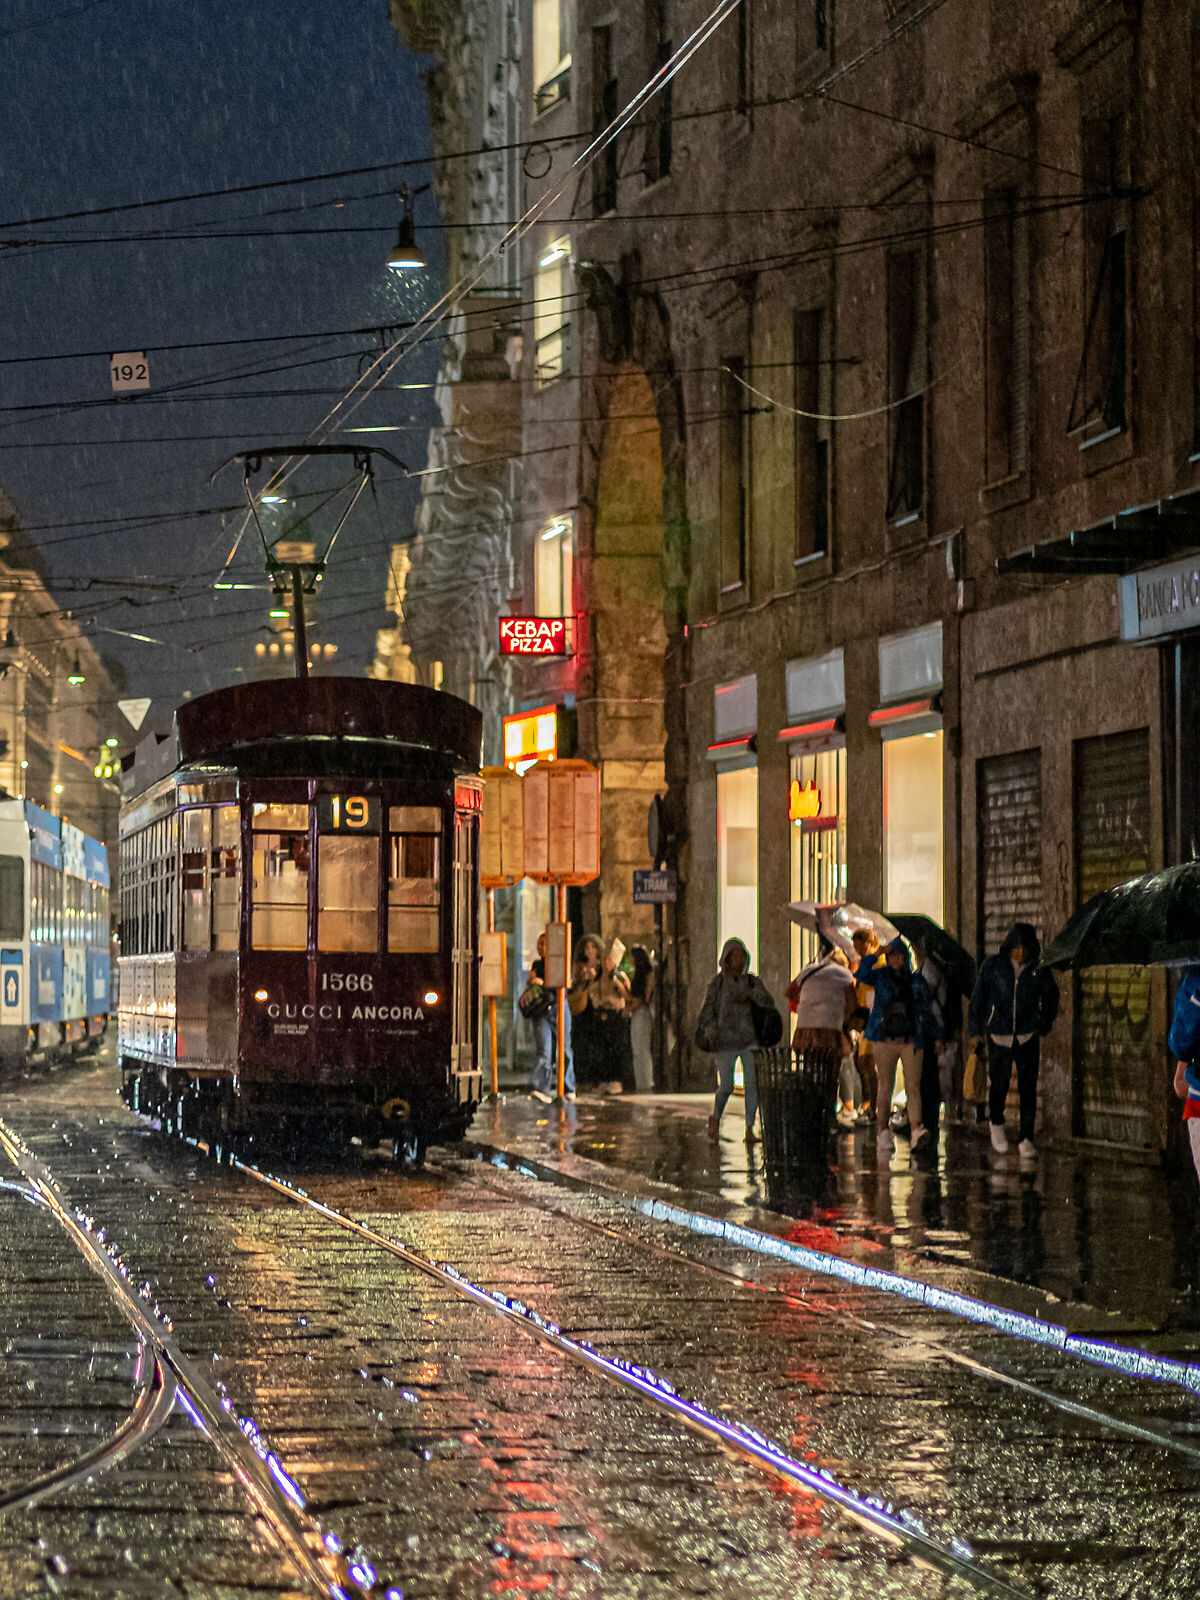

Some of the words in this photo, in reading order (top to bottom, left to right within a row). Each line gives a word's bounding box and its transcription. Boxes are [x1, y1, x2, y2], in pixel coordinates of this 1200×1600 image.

[112, 364, 147, 381] 192
[1181, 568, 1200, 609] PO
[501, 620, 563, 638] KEBAP
[510, 638, 555, 652] PIZZA
[331, 794, 369, 828] 19
[643, 878, 668, 891] TRAM
[321, 972, 374, 992] 1566
[267, 1003, 342, 1020] GUCCI
[351, 1005, 425, 1021] ANCORA
